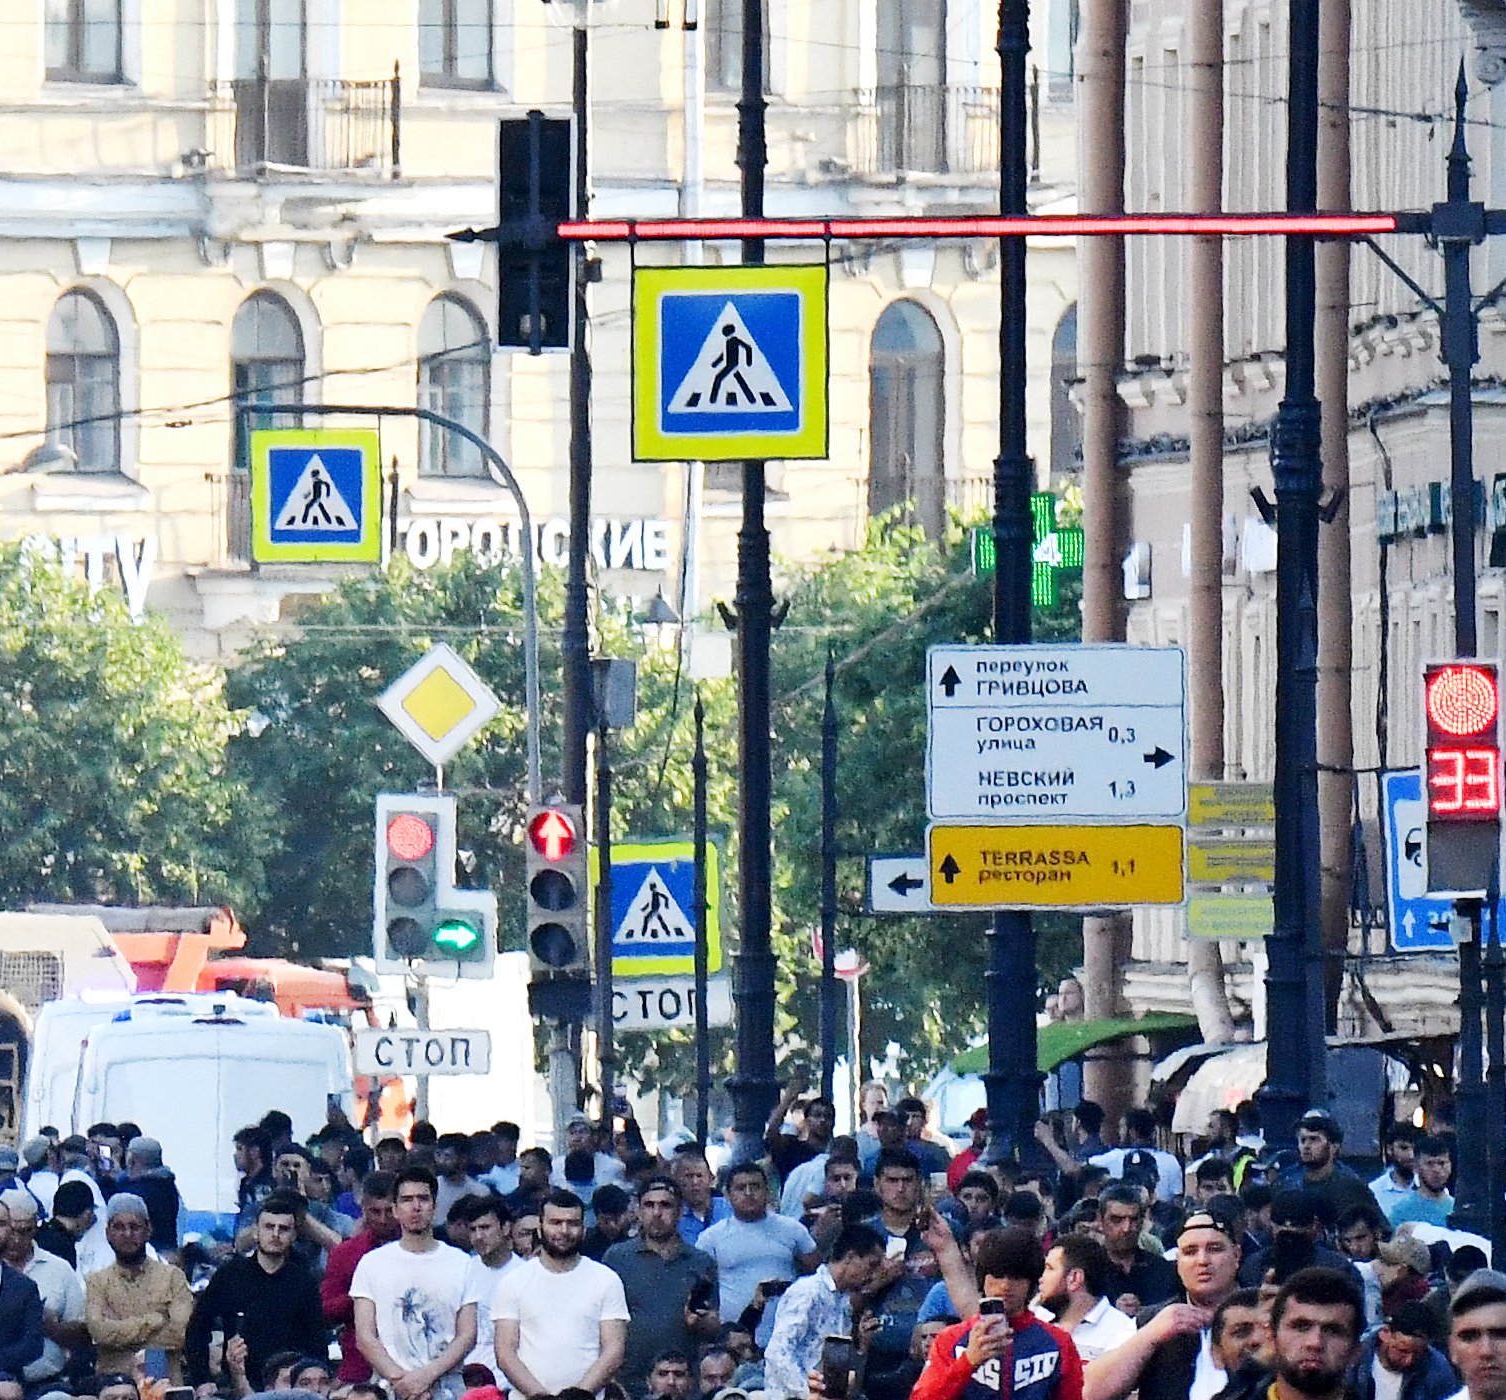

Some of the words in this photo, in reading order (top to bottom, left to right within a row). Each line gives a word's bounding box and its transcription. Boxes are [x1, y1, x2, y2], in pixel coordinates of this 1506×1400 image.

[976, 659, 1069, 676] переулок
[976, 679, 1089, 698] ГРИВЦОВА
[976, 716, 1104, 732] ГОРОХОВАЯ
[1108, 727, 1136, 744] 0,3
[976, 738, 1036, 754] улица
[978, 768, 1075, 787] НЕВСКИЙ
[1429, 749, 1498, 812] 33
[1108, 780, 1136, 800] 1,3
[978, 793, 1068, 809] проспект
[980, 850, 1091, 866] TERRASSA
[1113, 859, 1136, 877] 1,1
[978, 869, 1071, 885] ресторан
[375, 1037, 471, 1067] СТОП
